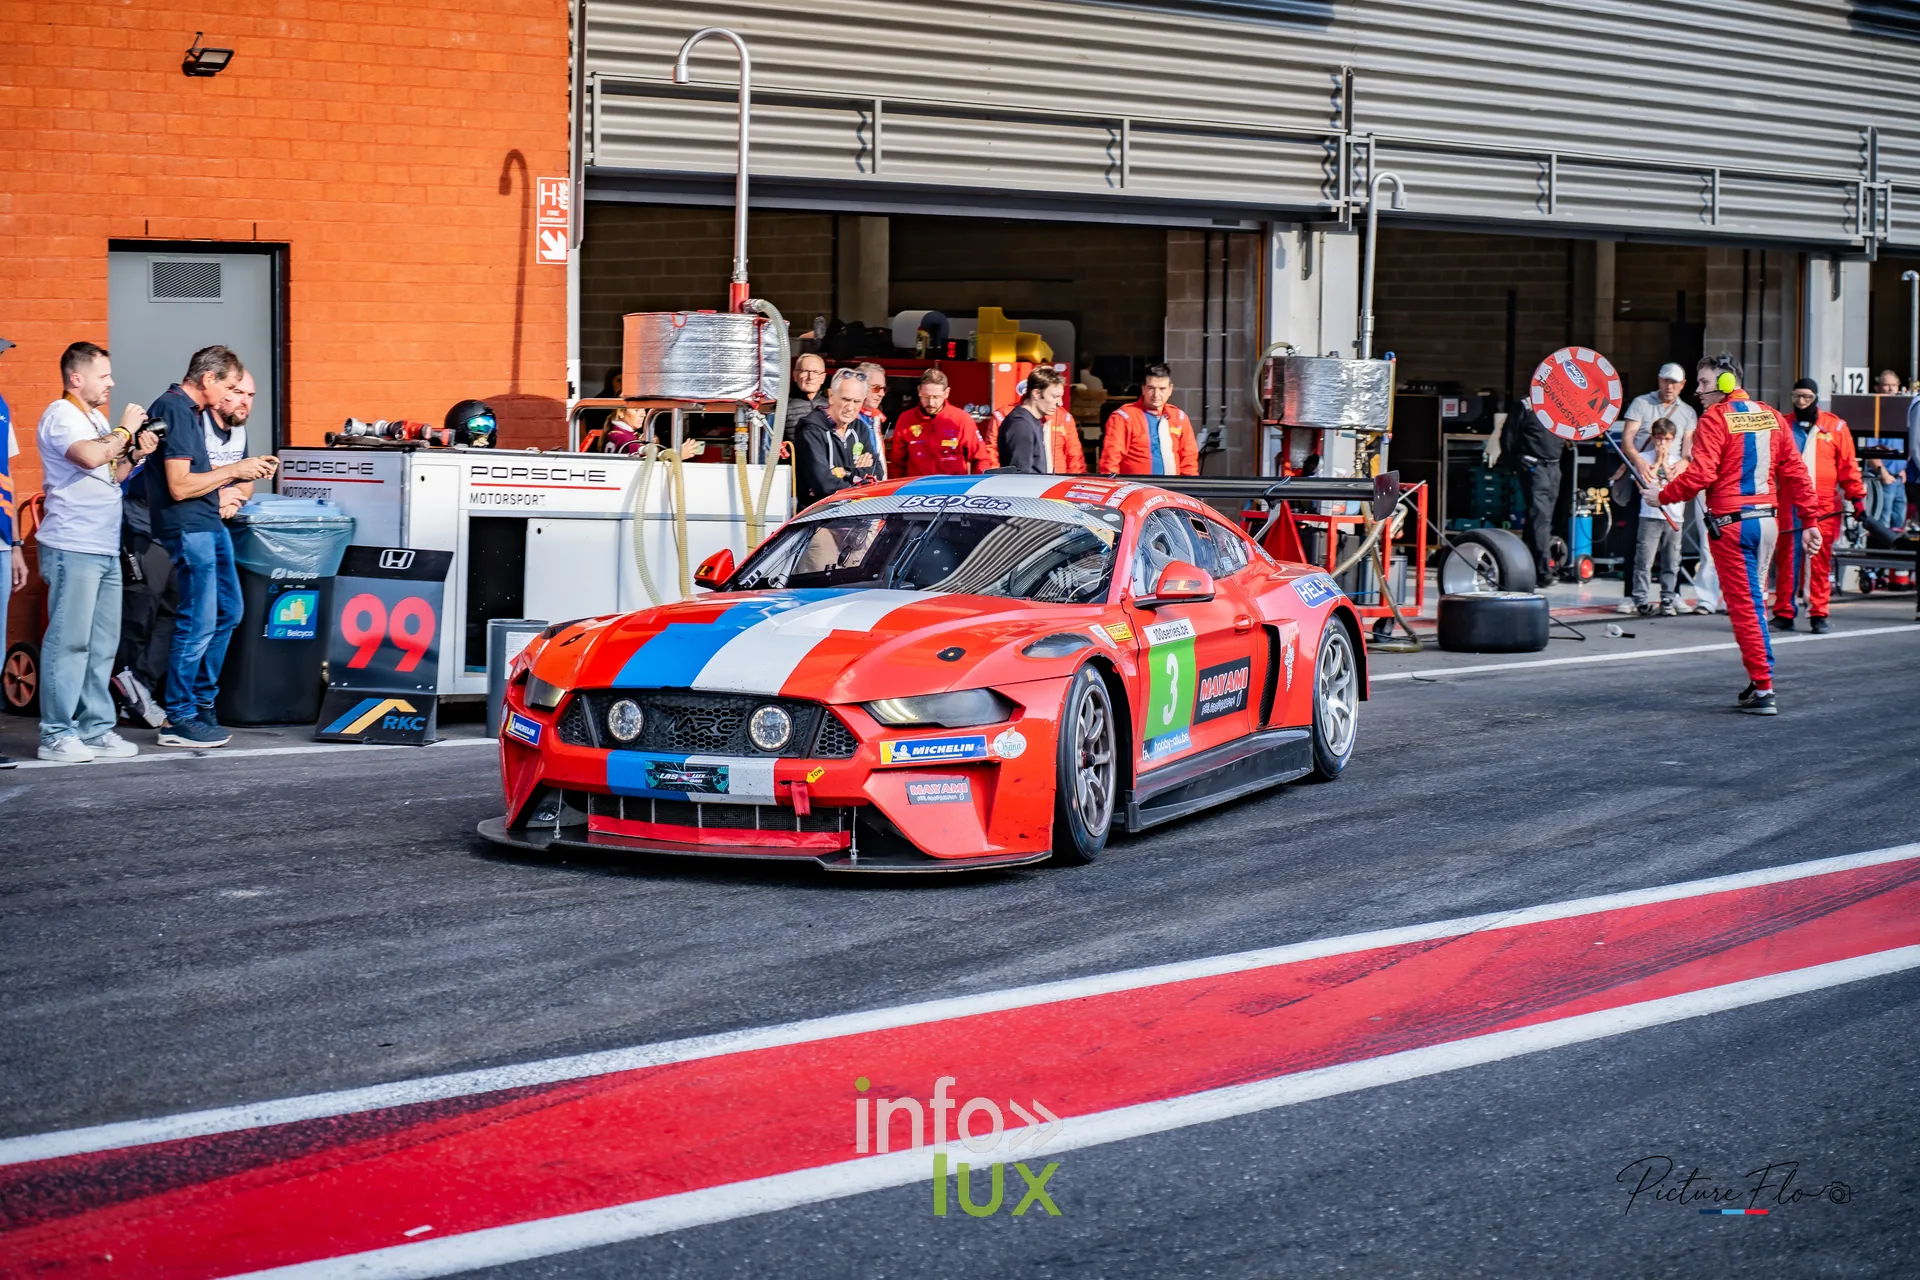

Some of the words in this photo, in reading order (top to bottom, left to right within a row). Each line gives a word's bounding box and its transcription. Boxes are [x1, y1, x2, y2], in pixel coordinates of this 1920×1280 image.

[1848, 373, 1864, 395] 12
[1537, 374, 1586, 437] VANSPRINGEL
[1544, 368, 1596, 429] Automobiles
[283, 460, 374, 475] PORSCHE
[470, 466, 606, 482] PORSCHE
[282, 486, 332, 499] MOTORSPORT
[469, 493, 546, 506] MOTORSPORT
[900, 494, 1012, 511] BGDC.be
[1296, 578, 1326, 603] HELP
[341, 593, 436, 672] 99
[1152, 621, 1190, 642] 100series.be
[1162, 653, 1179, 726] 3
[1199, 666, 1249, 702] MAYAMI
[382, 715, 427, 731] RKC
[514, 721, 536, 737] MICHELIN
[1153, 730, 1190, 751] hobby-alu.be
[912, 743, 975, 756] MICHELIN
[811, 768, 823, 779] TOW
[909, 783, 969, 796] MAYAMI
